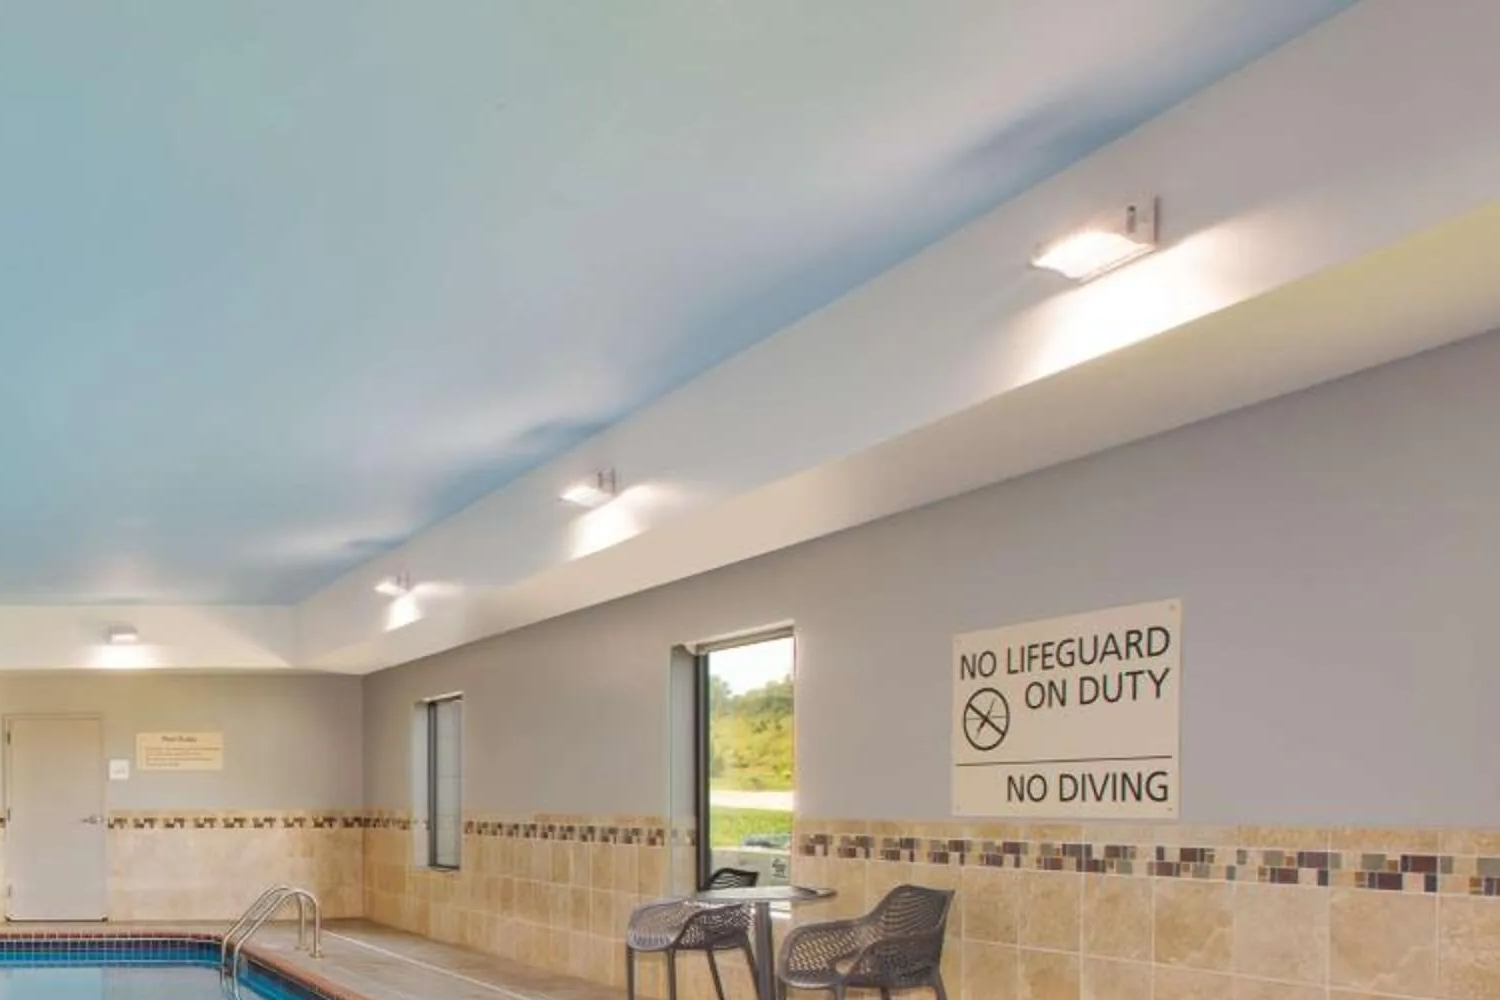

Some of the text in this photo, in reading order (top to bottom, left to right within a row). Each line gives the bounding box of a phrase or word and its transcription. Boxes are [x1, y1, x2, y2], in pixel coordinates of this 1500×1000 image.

[960, 626, 1171, 680] NO LIFEGUARD
[1024, 667, 1171, 710] ON DUTY
[1006, 771, 1169, 803] NO DIVING
